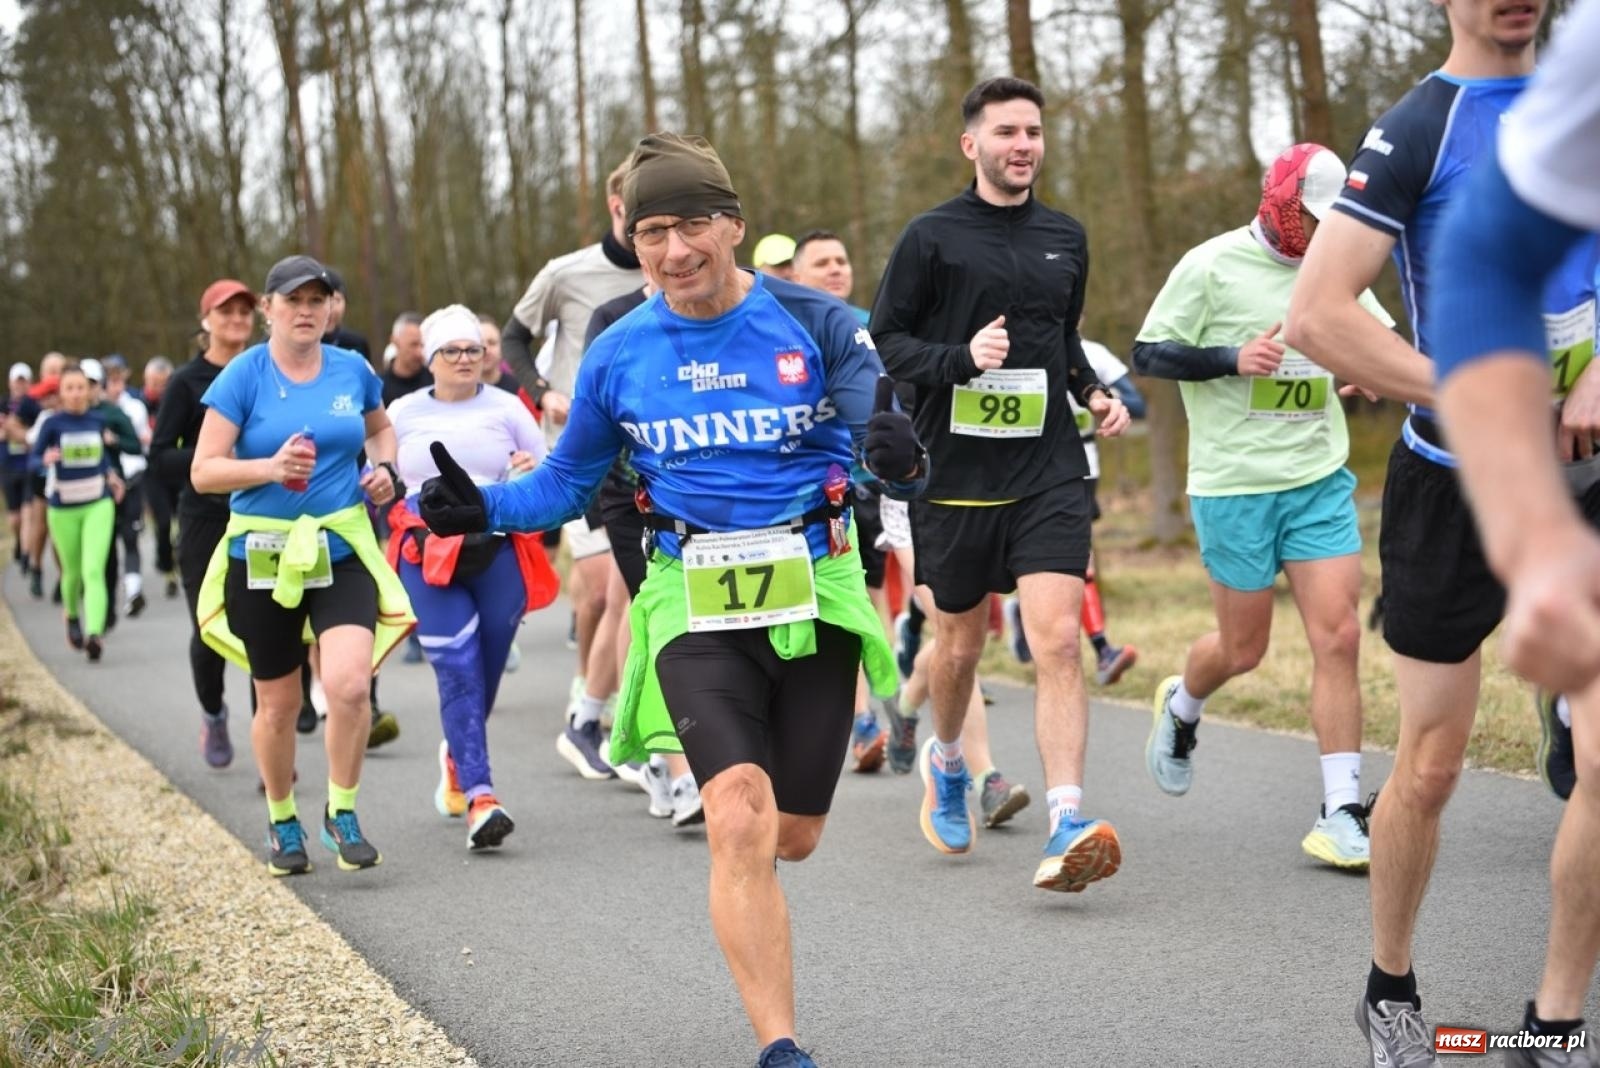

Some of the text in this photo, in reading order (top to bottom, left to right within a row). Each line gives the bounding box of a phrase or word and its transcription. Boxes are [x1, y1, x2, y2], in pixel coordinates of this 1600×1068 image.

[980, 394, 1021, 424] 98
[1275, 380, 1311, 409] 70
[619, 396, 837, 454] RUNNERS
[717, 564, 775, 611] 17
